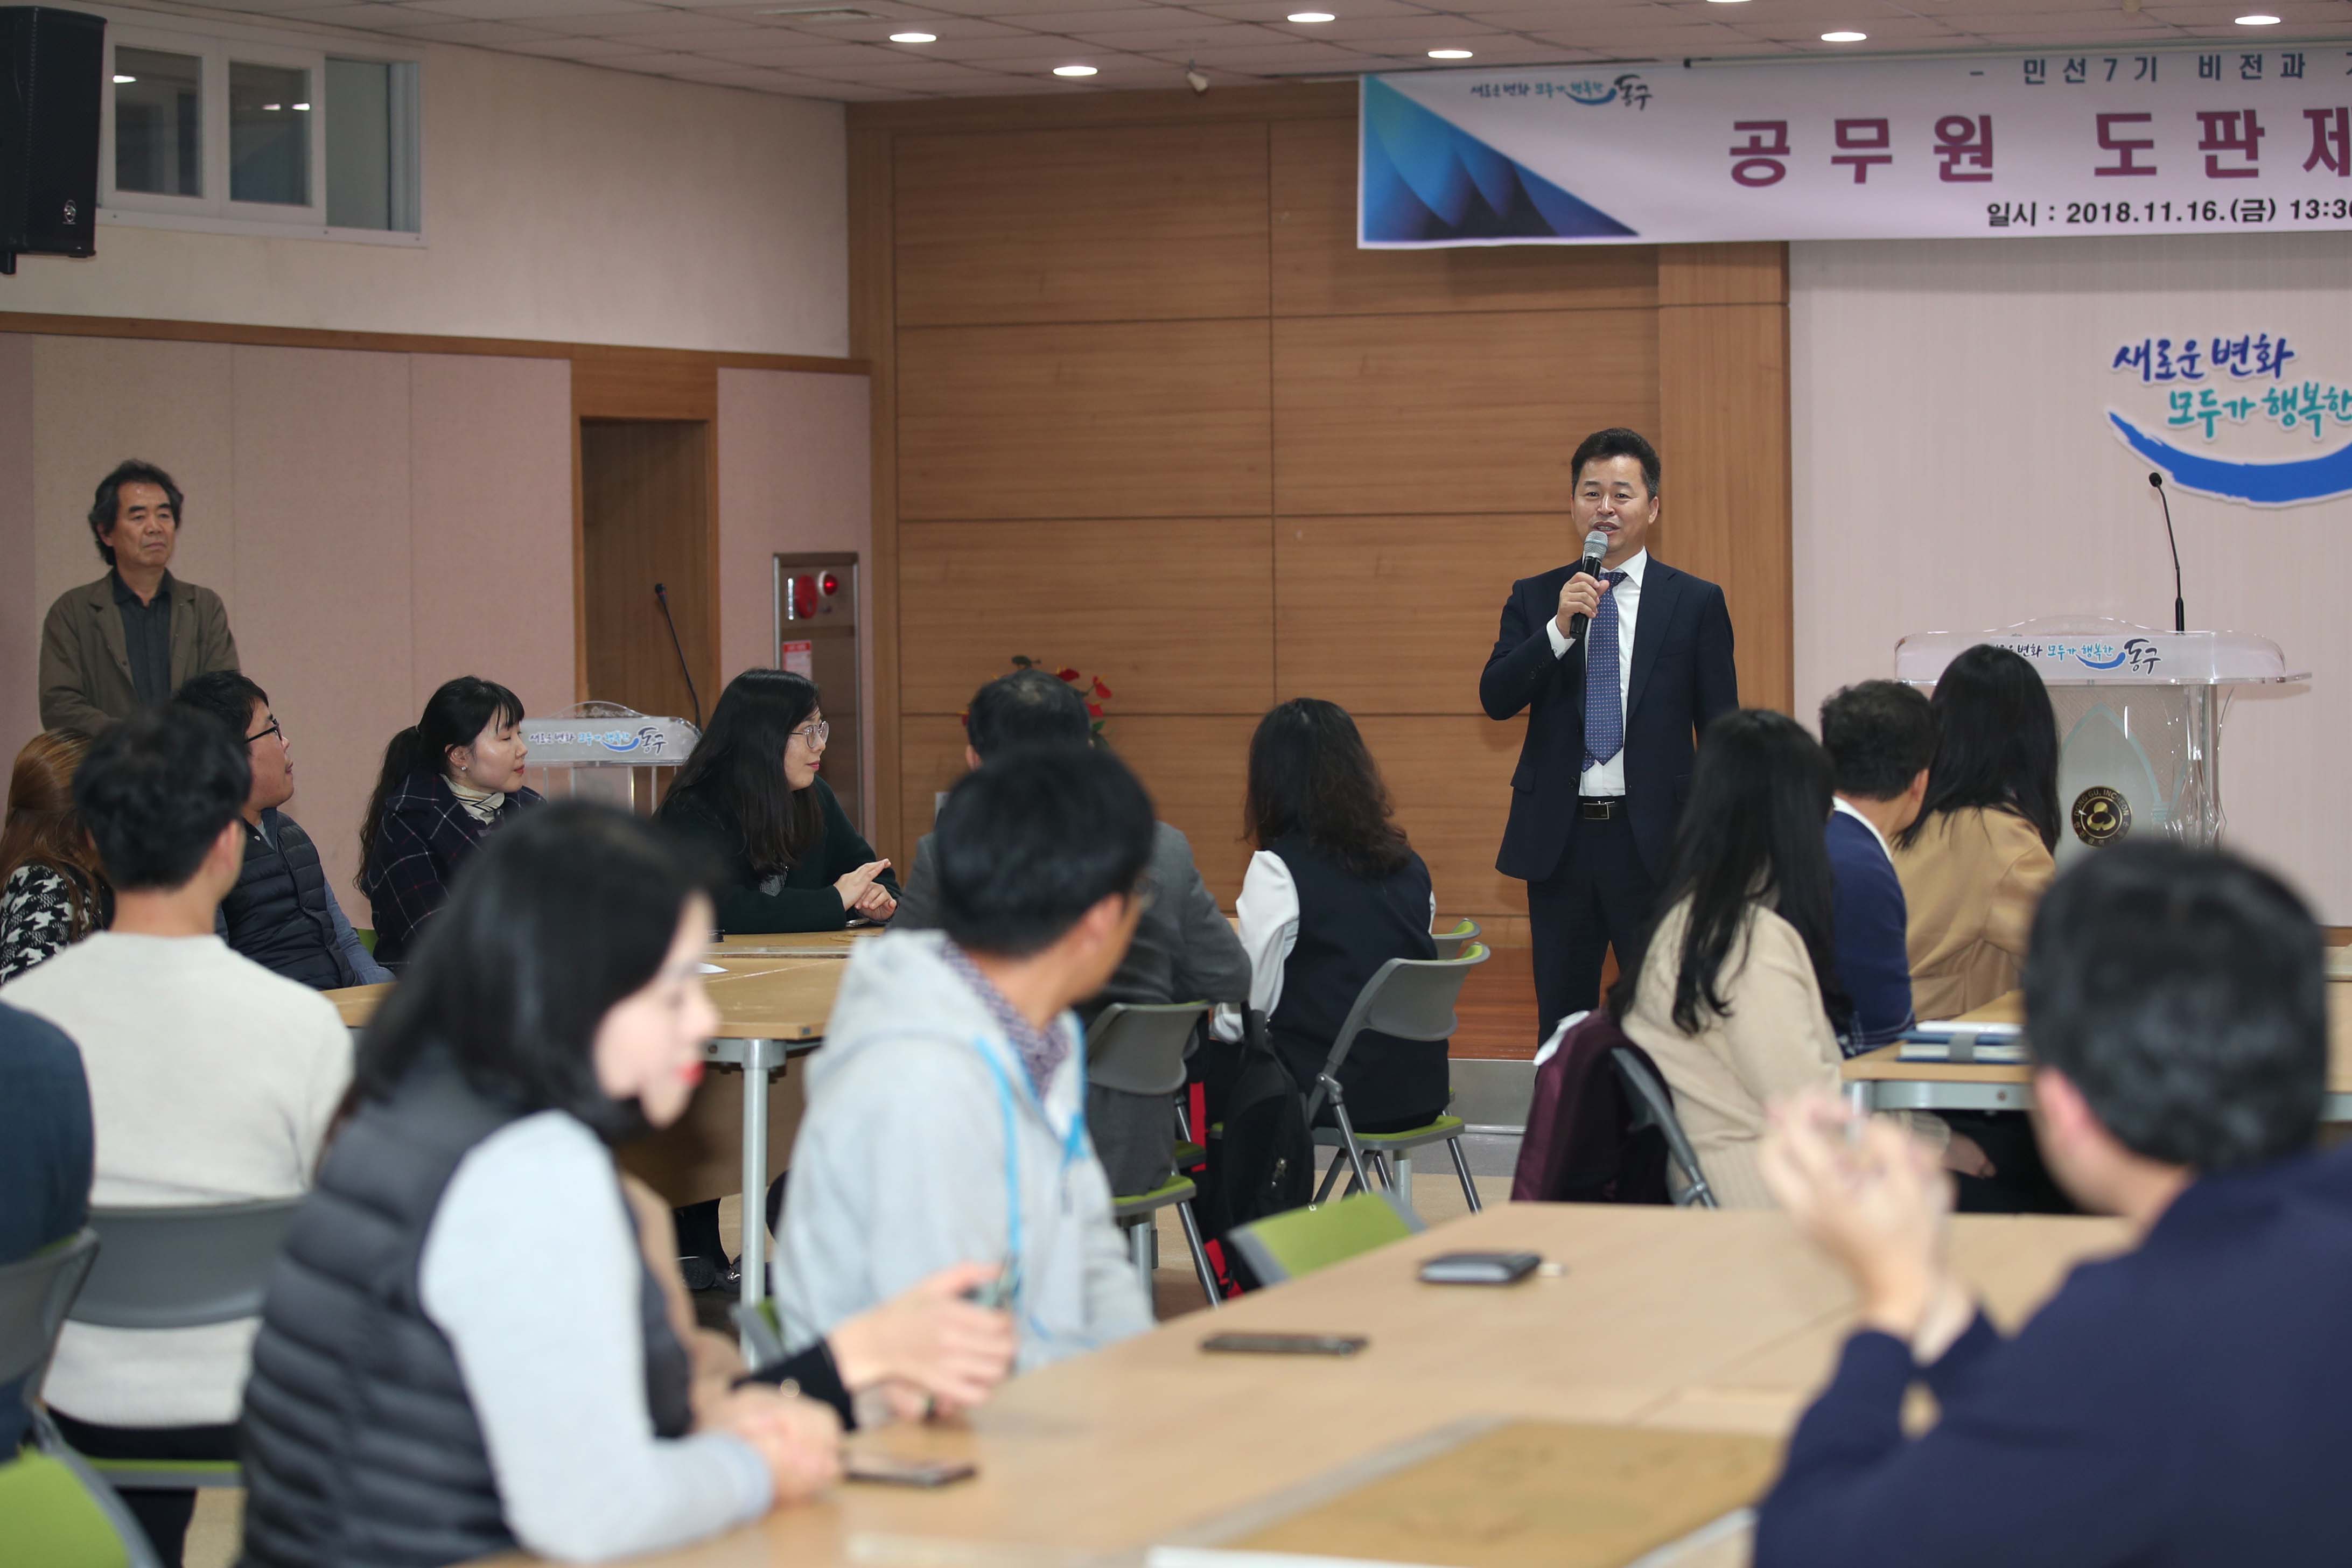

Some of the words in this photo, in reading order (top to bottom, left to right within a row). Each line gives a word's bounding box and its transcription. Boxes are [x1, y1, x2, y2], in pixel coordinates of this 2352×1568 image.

[2023, 55, 2157, 85] 민선7기
[2199, 52, 2306, 81] 비전과
[1614, 74, 1653, 110] 동구
[1729, 114, 1993, 187] 공무원
[1987, 202, 2036, 227] 일시
[2067, 198, 2276, 223] 2018.11.16.(금)
[2290, 199, 2352, 220] 13:3
[2113, 339, 2204, 382] 새로운
[2211, 333, 2295, 379] 변화
[2168, 389, 2256, 438] 모두가
[2262, 381, 2352, 437] 행복한
[2017, 643, 2042, 658] 변화
[2048, 643, 2077, 661] 모두가
[2081, 642, 2113, 661] 행복한
[2124, 638, 2161, 674] 동구
[638, 727, 667, 754] 동구
